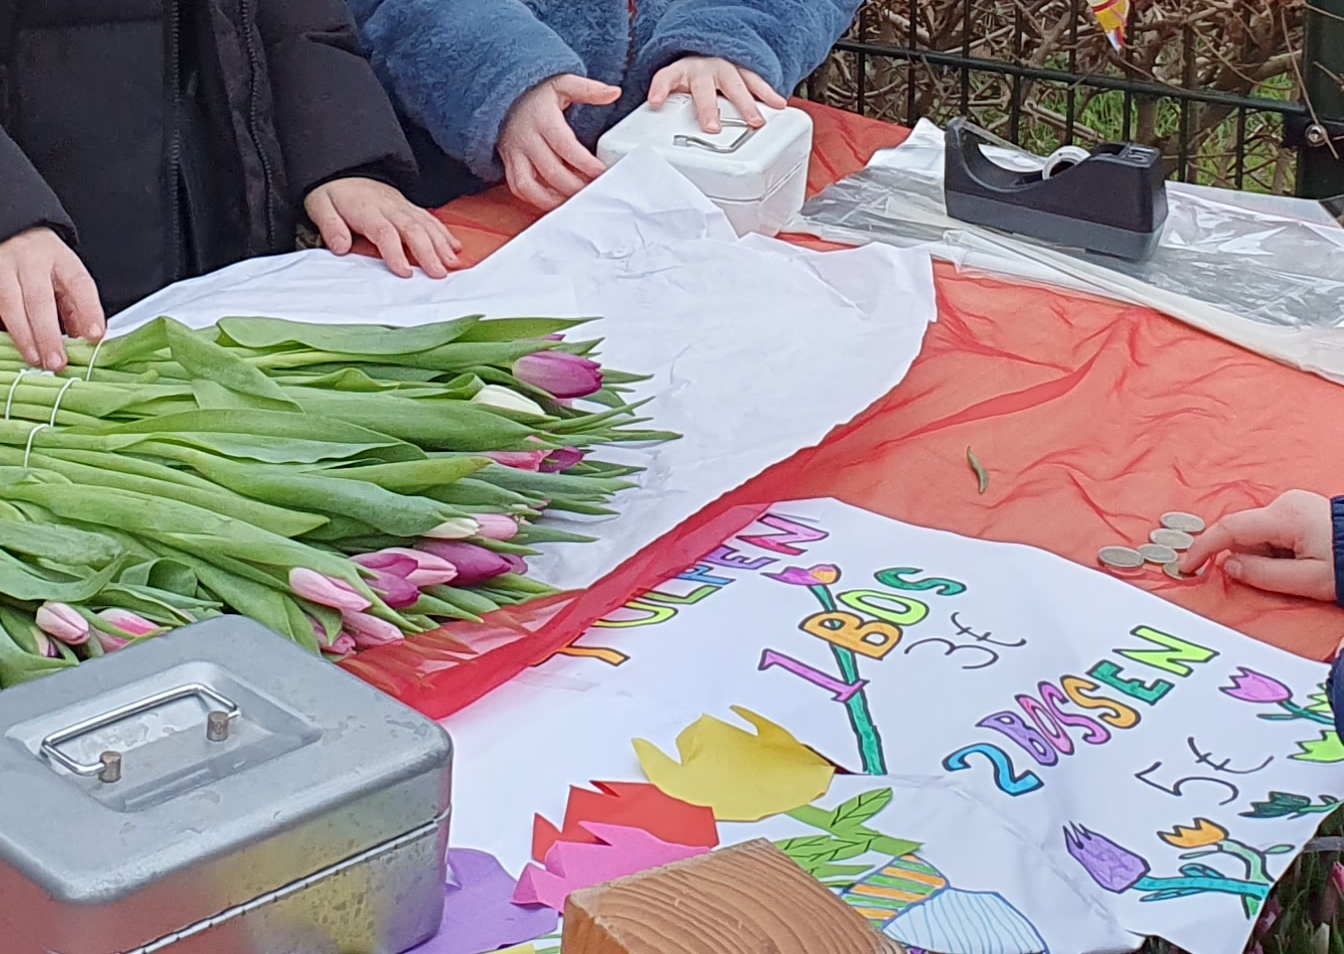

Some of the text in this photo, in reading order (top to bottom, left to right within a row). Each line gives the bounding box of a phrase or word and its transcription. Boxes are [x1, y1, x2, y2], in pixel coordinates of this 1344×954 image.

[530, 513, 830, 667] TULPEN
[757, 567, 968, 703] 1 BOS
[942, 625, 1221, 797] 2 BOSSEN
